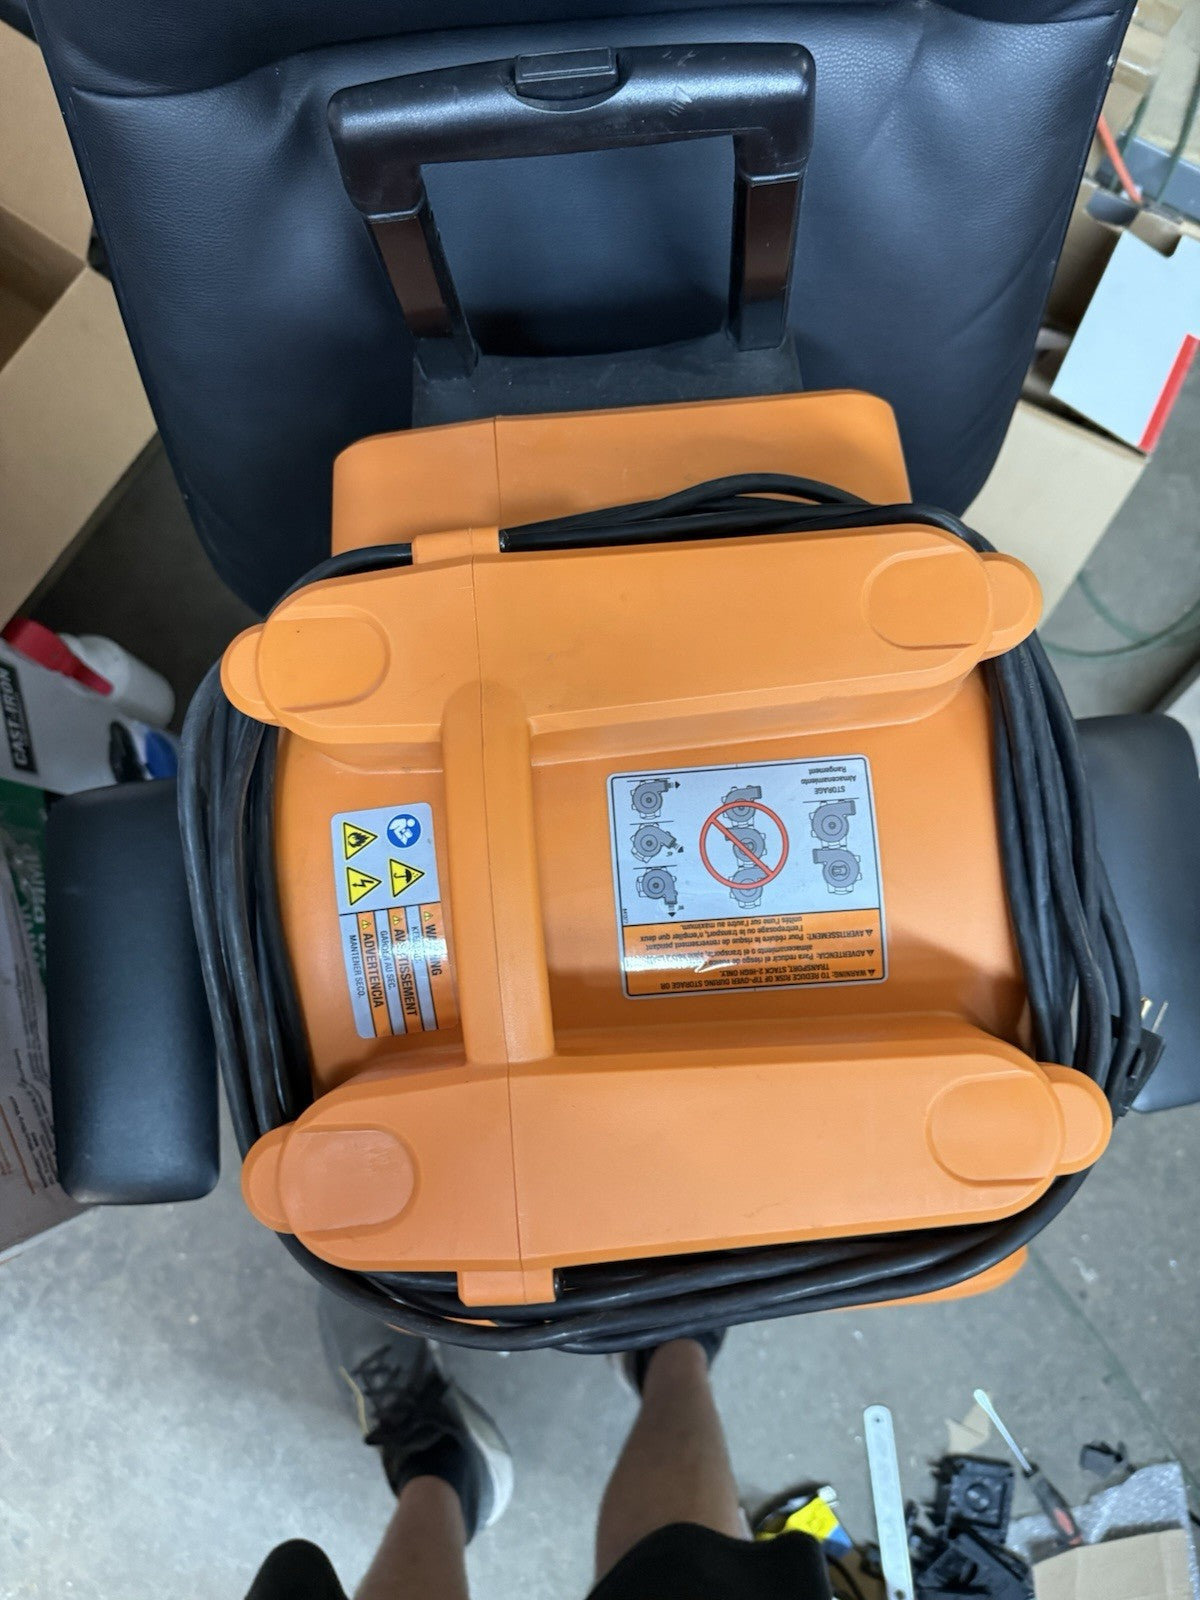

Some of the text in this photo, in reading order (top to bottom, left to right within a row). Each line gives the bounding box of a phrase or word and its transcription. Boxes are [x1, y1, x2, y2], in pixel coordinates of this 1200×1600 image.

[809, 766, 846, 775] Rangement
[801, 775, 856, 785] Almacenamiento
[814, 786, 845, 794] STORAGE
[640, 935, 656, 943] deux
[807, 930, 864, 940] AVERTISSEMENT:
[732, 936, 753, 945] risque
[425, 925, 442, 976] WAING
[646, 943, 673, 951] pendant
[757, 945, 812, 954] almacenamiento
[773, 954, 796, 963] reducir
[817, 950, 865, 959] ADVERTENCIA:
[349, 935, 365, 998] MANTENER SECO.
[363, 934, 384, 1007] ADVERTENCIA
[385, 962, 392, 972] AU
[764, 966, 786, 974] STACK
[739, 968, 763, 976] 2-HIGH
[832, 970, 867, 978] WARNING:
[732, 977, 762, 985] TIP-OVER
[792, 973, 819, 981] REDUCE
[387, 974, 396, 990] SEC.
[672, 980, 702, 988] STORAGE
[704, 979, 730, 987] DURING
